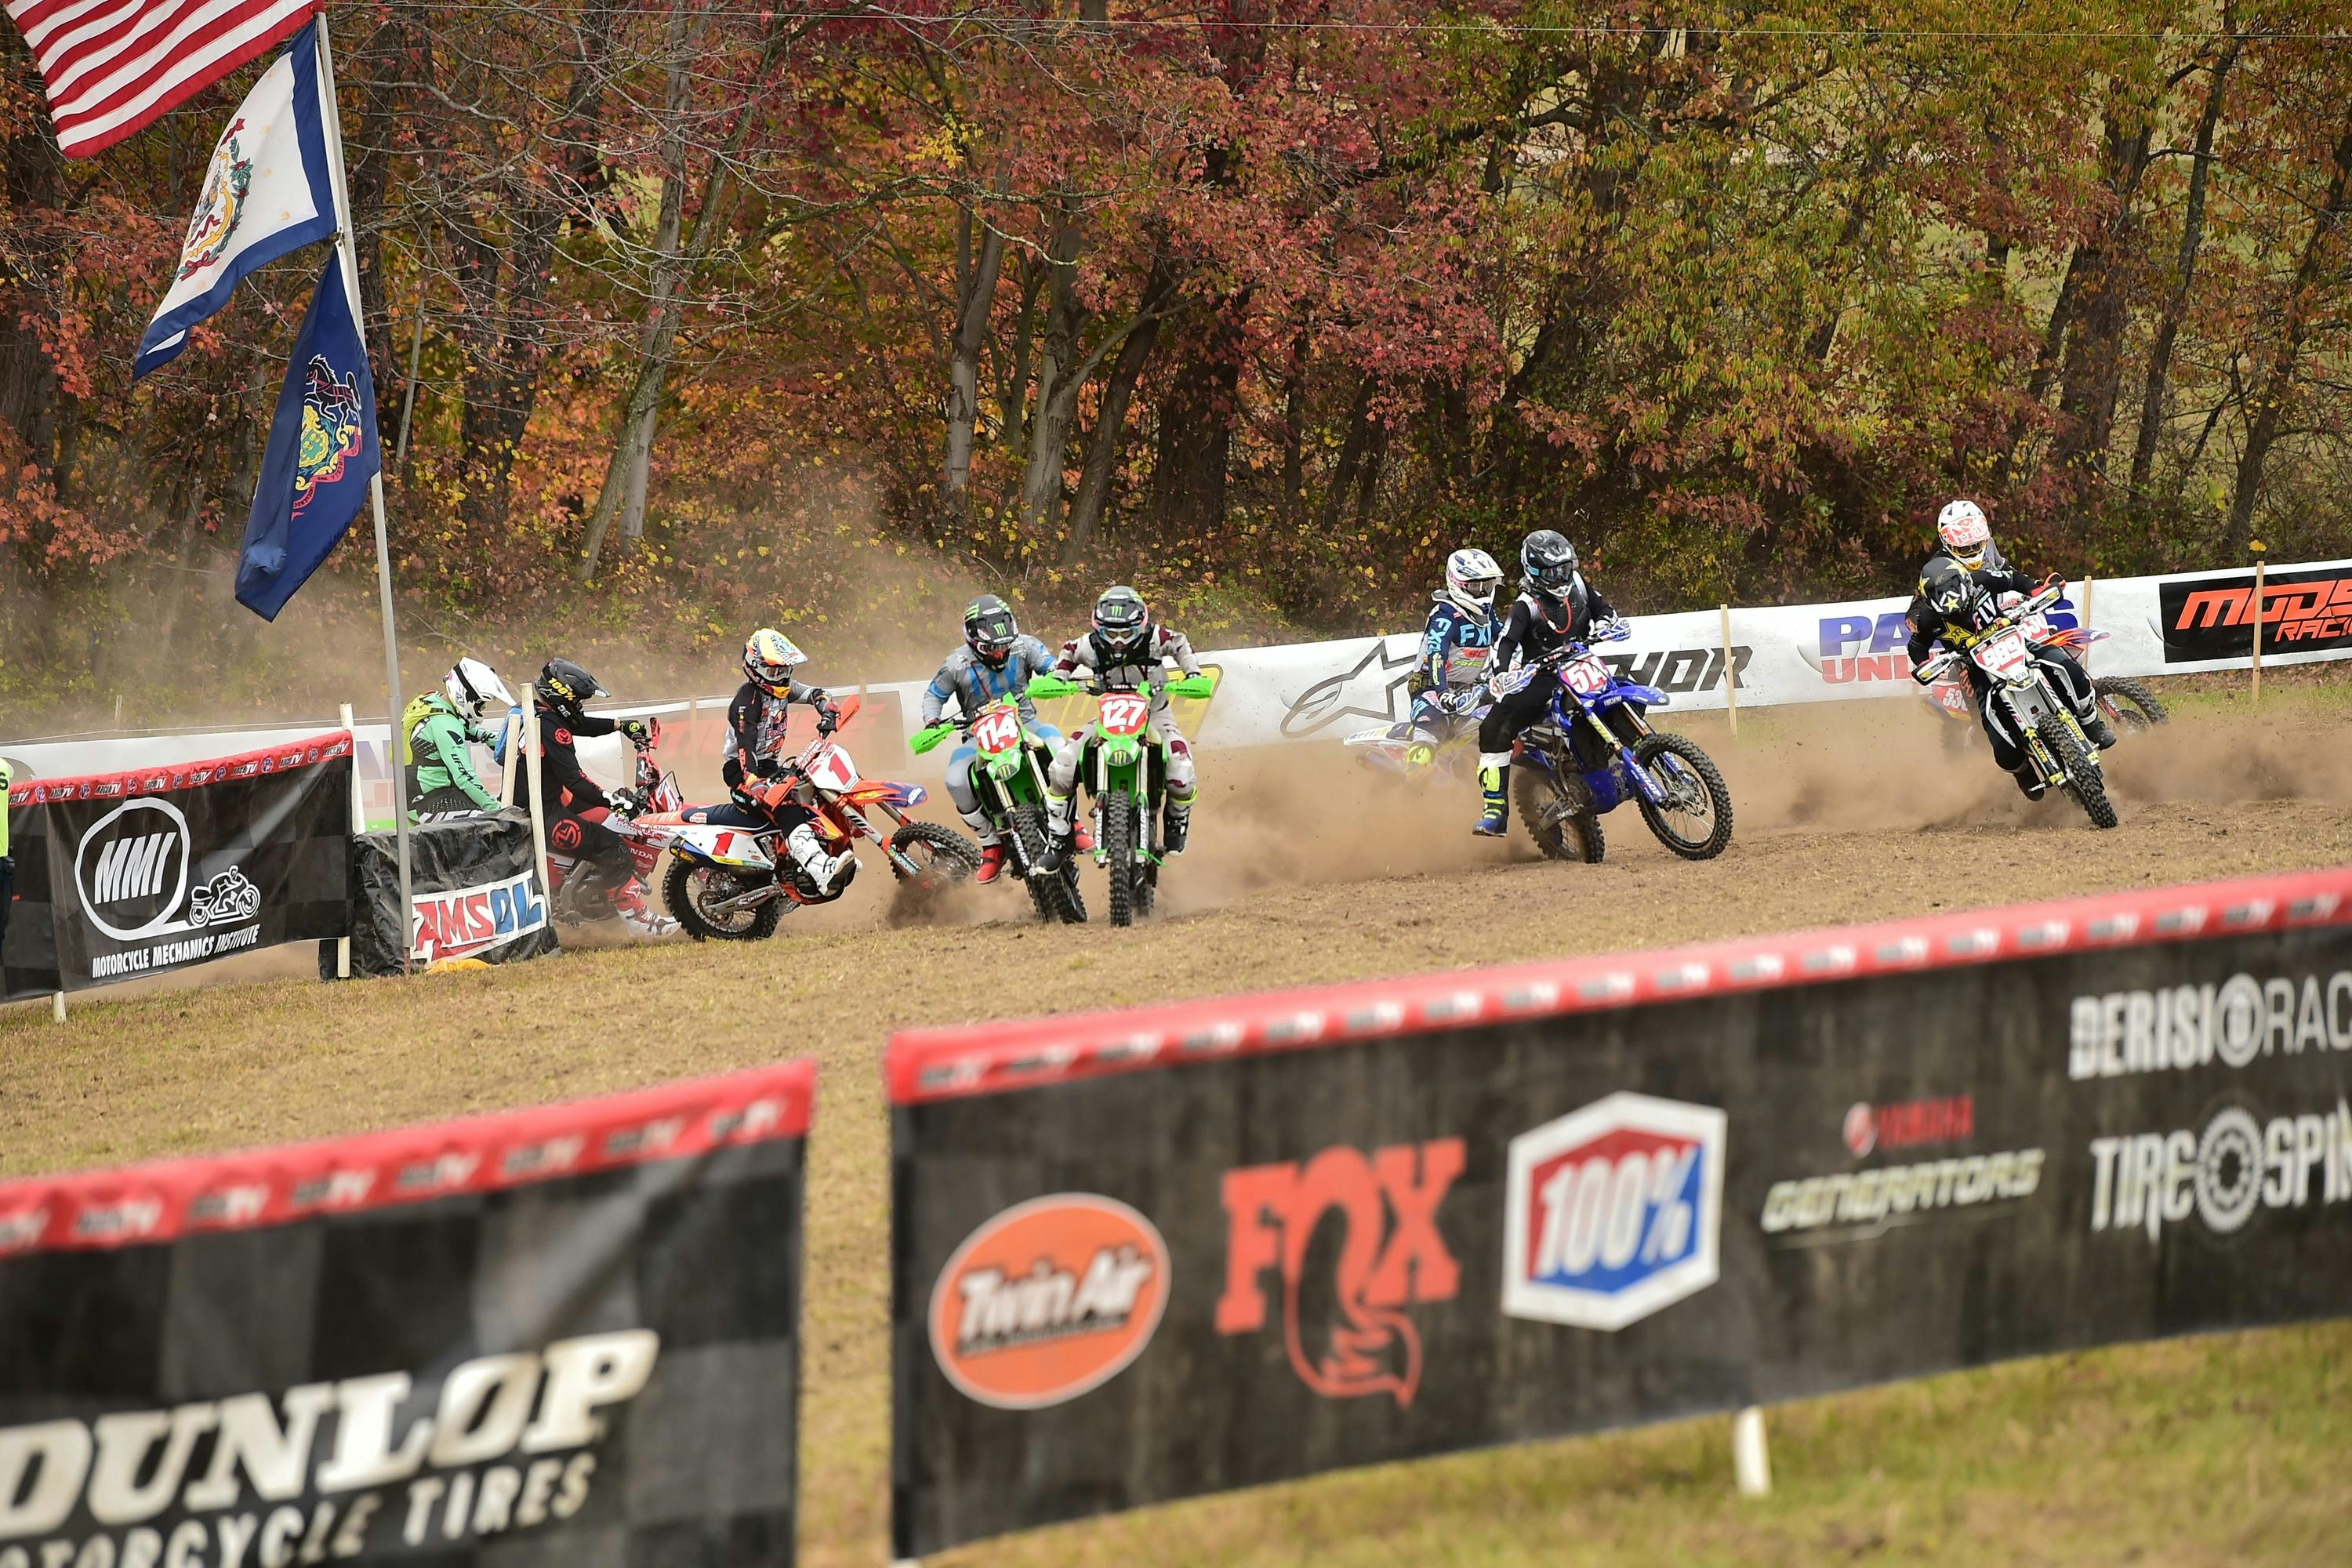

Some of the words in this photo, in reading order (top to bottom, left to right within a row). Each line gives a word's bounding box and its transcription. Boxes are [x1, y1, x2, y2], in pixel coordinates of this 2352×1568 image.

[1427, 617, 1452, 655] FXR
[2274, 617, 2352, 641] RACI
[1981, 635, 2024, 667] 989
[548, 677, 577, 701] 100%
[1565, 655, 1608, 694] 514
[976, 711, 1018, 751] 114
[1101, 699, 1146, 728] 127
[829, 753, 851, 786] 1
[1631, 760, 1661, 797] DUNLOP
[629, 847, 654, 860] NDA
[712, 832, 735, 857] 1
[95, 832, 176, 904] MMI
[414, 877, 542, 958] AMSOIL
[93, 948, 149, 978] MOTORCYCLE
[152, 935, 214, 967] MECHANICS
[213, 924, 260, 953] INSTITUTE
[1536, 1141, 1697, 1279] 100%
[1760, 1147, 2045, 1234] GENERATORS
[1216, 1138, 1468, 1403] FOX
[958, 1258, 1077, 1343] Twin
[1071, 1245, 1152, 1320] Air
[0, 1328, 660, 1538] DUNLOP
[401, 1451, 597, 1547] TIRES
